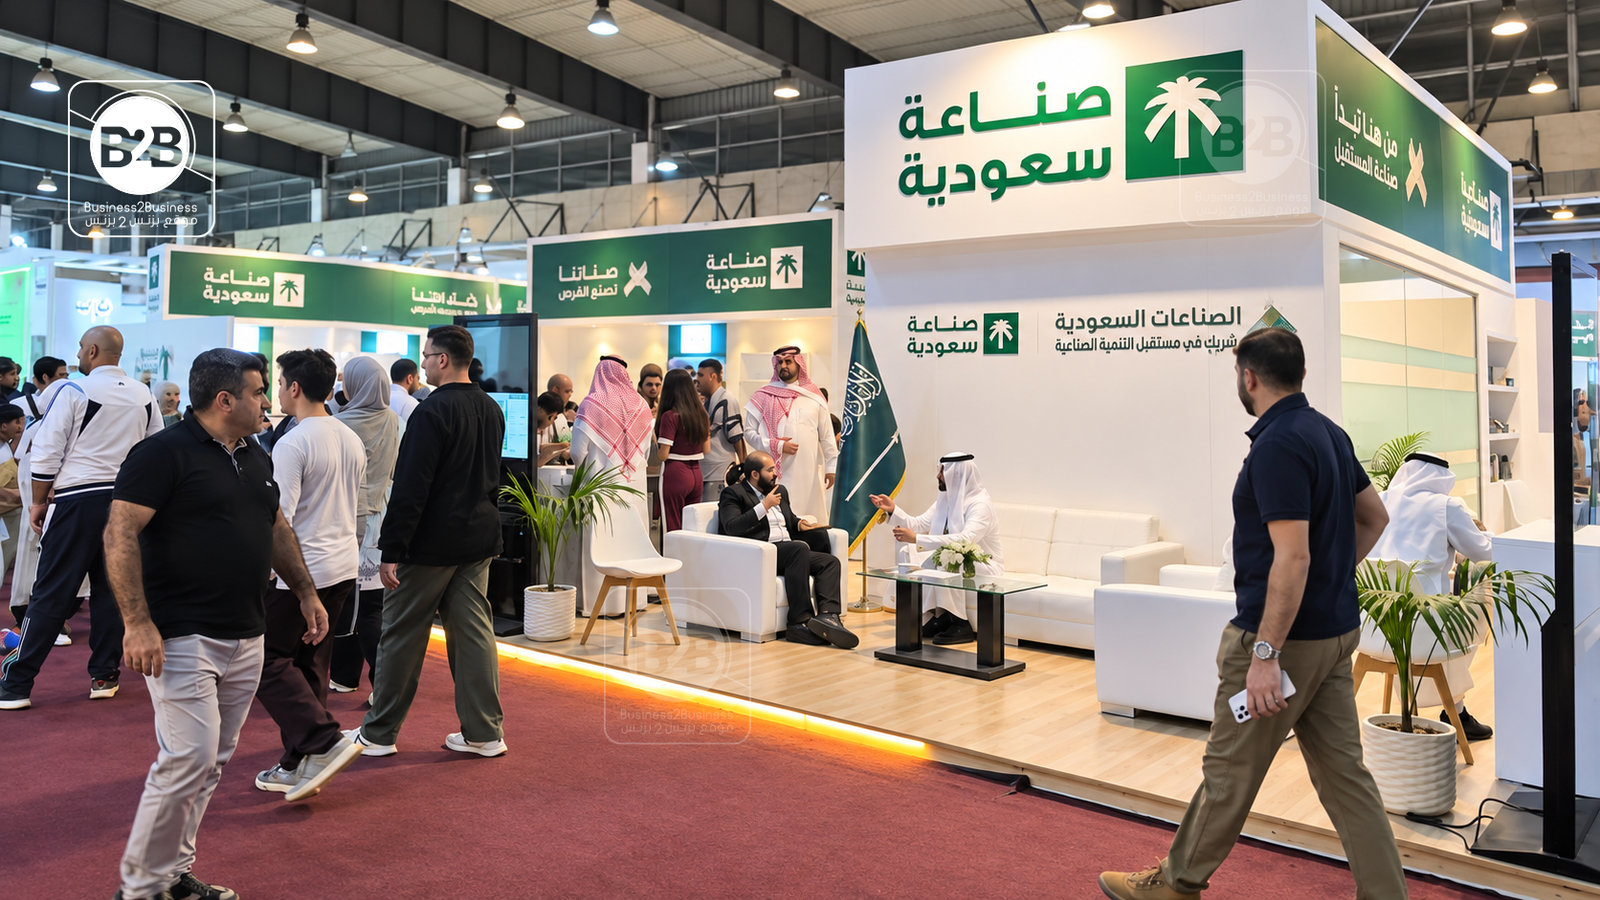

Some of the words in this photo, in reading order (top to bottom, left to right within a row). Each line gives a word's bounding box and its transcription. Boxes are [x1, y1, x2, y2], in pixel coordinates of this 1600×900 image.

[899, 81, 1111, 139] صناعة
[1334, 85, 1361, 140] تبدأ
[1362, 112, 1382, 148] هنا
[1383, 131, 1398, 159] من
[899, 147, 1111, 206] سعودية
[706, 252, 767, 270] صناعة
[203, 267, 270, 287] صناعة
[706, 274, 767, 294] سعودية
[202, 284, 270, 305] سعودية
[558, 285, 589, 301] الفرص
[590, 284, 618, 300] تصنع
[907, 315, 978, 333] صناعة
[1055, 309, 1145, 335] السعودية
[1151, 306, 1241, 327] الصناعات
[906, 337, 978, 358] سعودية
[1055, 338, 1097, 356] الصناعية
[1099, 337, 1134, 354] التنمية
[1136, 336, 1181, 353] مستقبل
[1182, 335, 1202, 353] في
